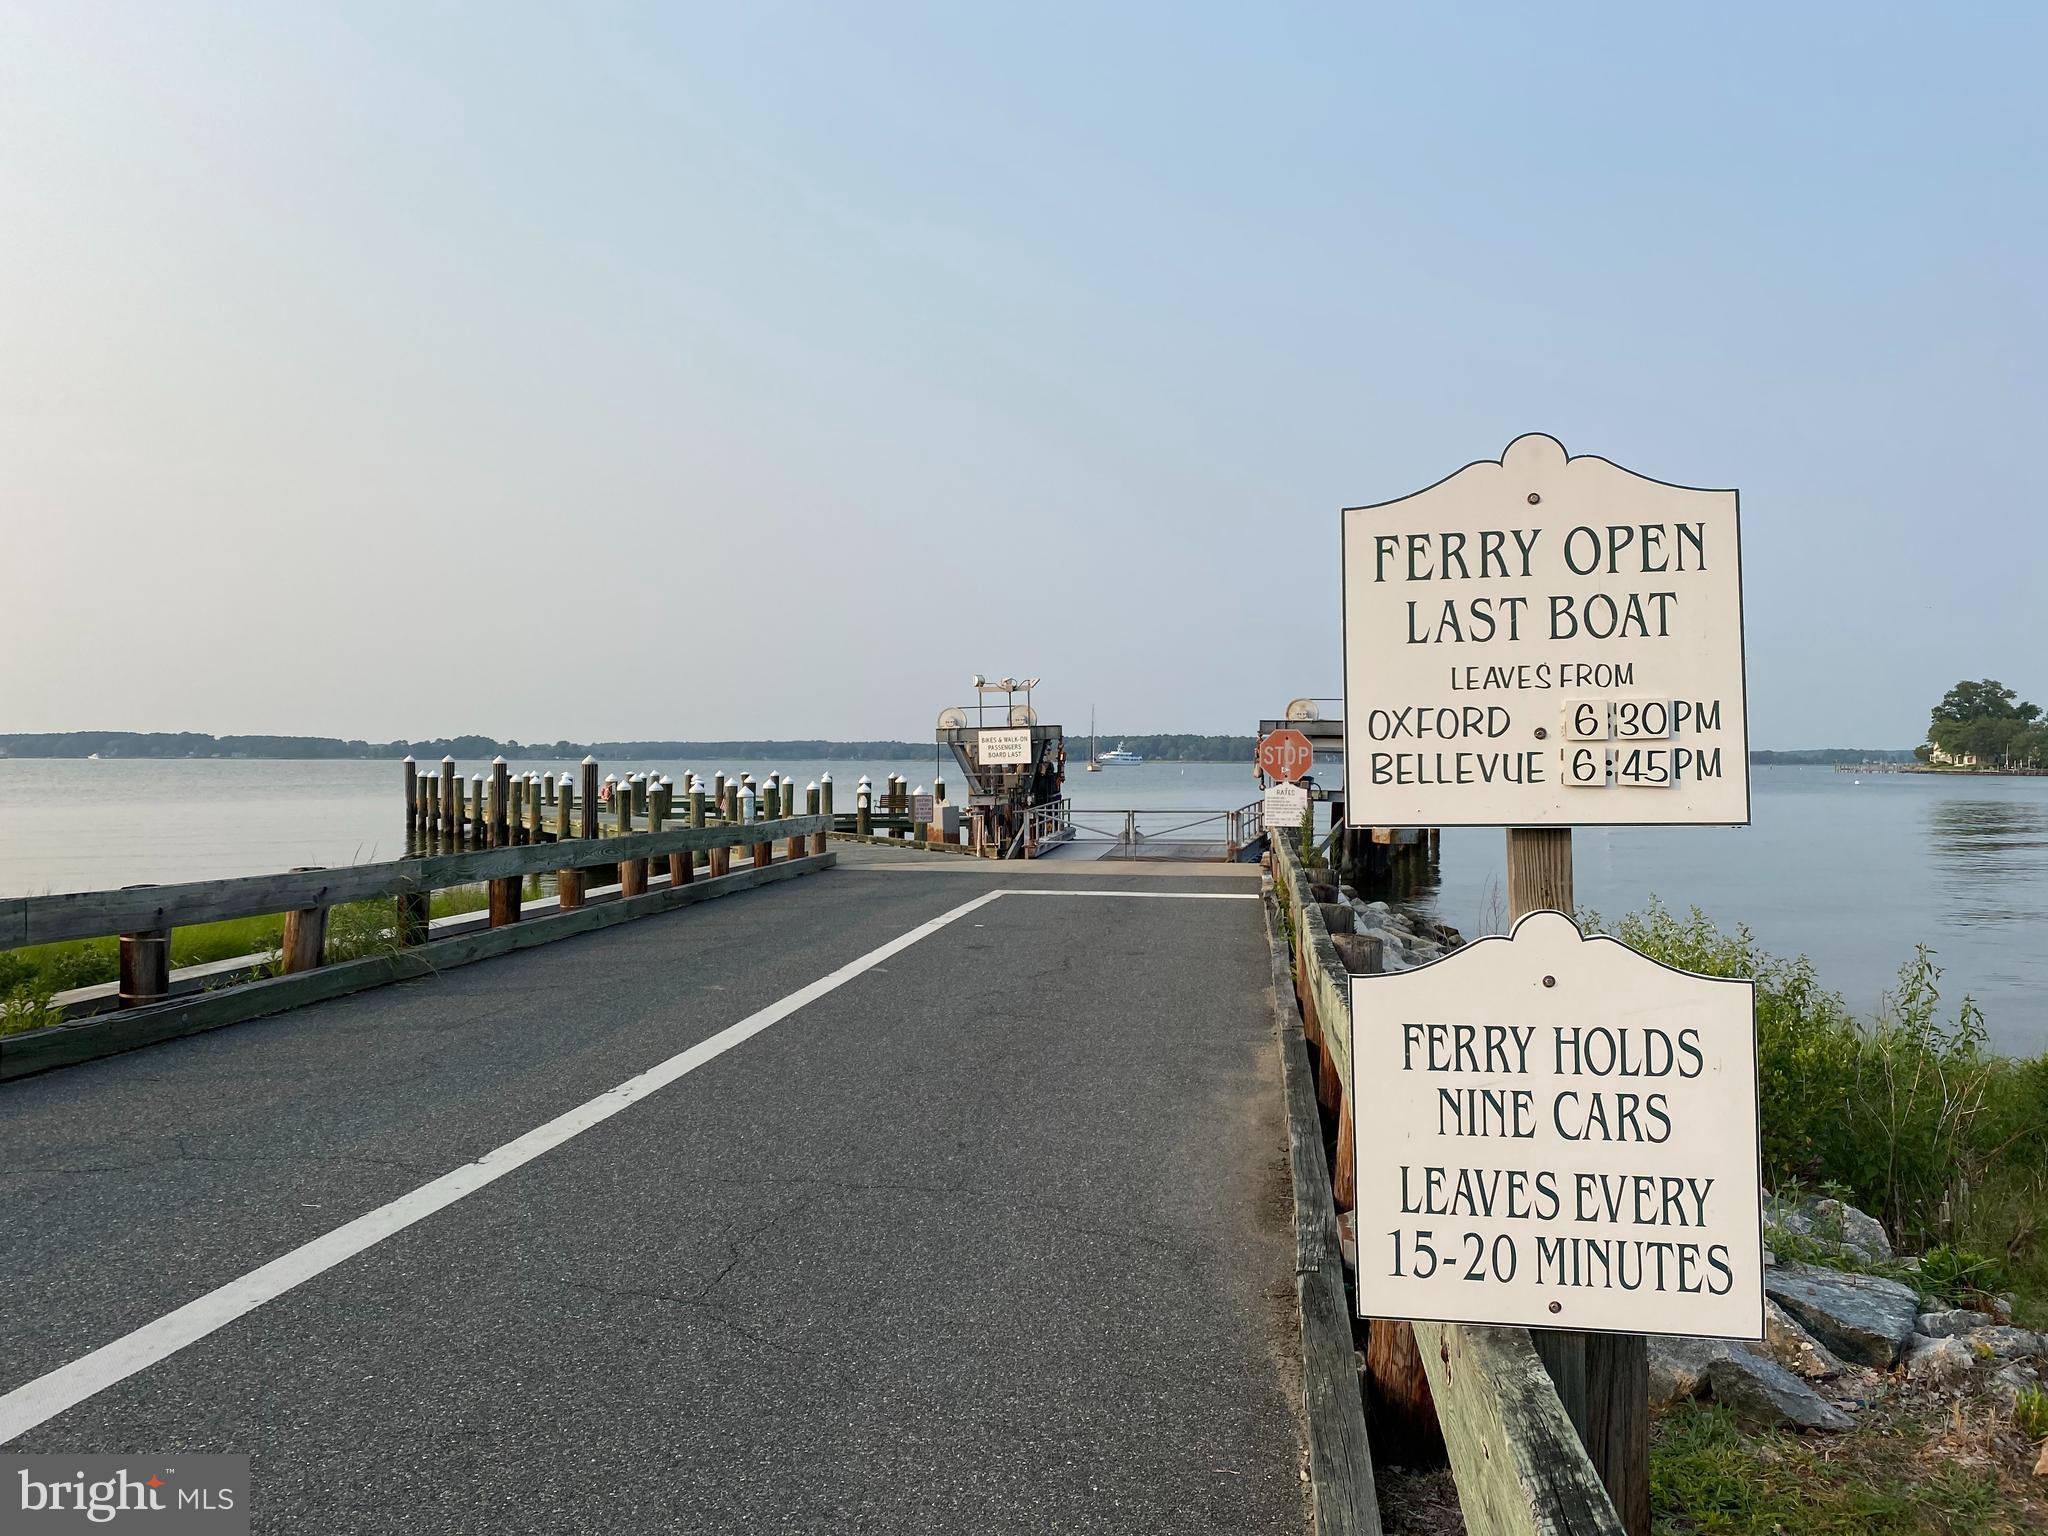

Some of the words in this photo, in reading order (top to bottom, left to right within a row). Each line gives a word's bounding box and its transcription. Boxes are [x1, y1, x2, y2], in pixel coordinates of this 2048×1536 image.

[1373, 529, 1542, 583] FERRY
[1563, 522, 1707, 576] OPEN
[1406, 597, 1528, 644] LAST
[1548, 592, 1678, 640] BOAT
[1451, 663, 1551, 690] LEAVES
[1559, 663, 1634, 688] FROM
[1368, 706, 1511, 741] OXFORD
[1264, 746, 1309, 766] STOP
[1371, 751, 1546, 785] BELLEVUE
[1401, 1023, 1537, 1073] FERRY
[1552, 1026, 1704, 1079] HOLDS
[1437, 1088, 1537, 1138] NINE
[1553, 1091, 1672, 1144] CARS
[1399, 1166, 1560, 1221] LEAVES
[1574, 1173, 1715, 1227] EVERY
[1387, 1229, 1517, 1283] 15-20
[1535, 1236, 1733, 1296] MINUTES
